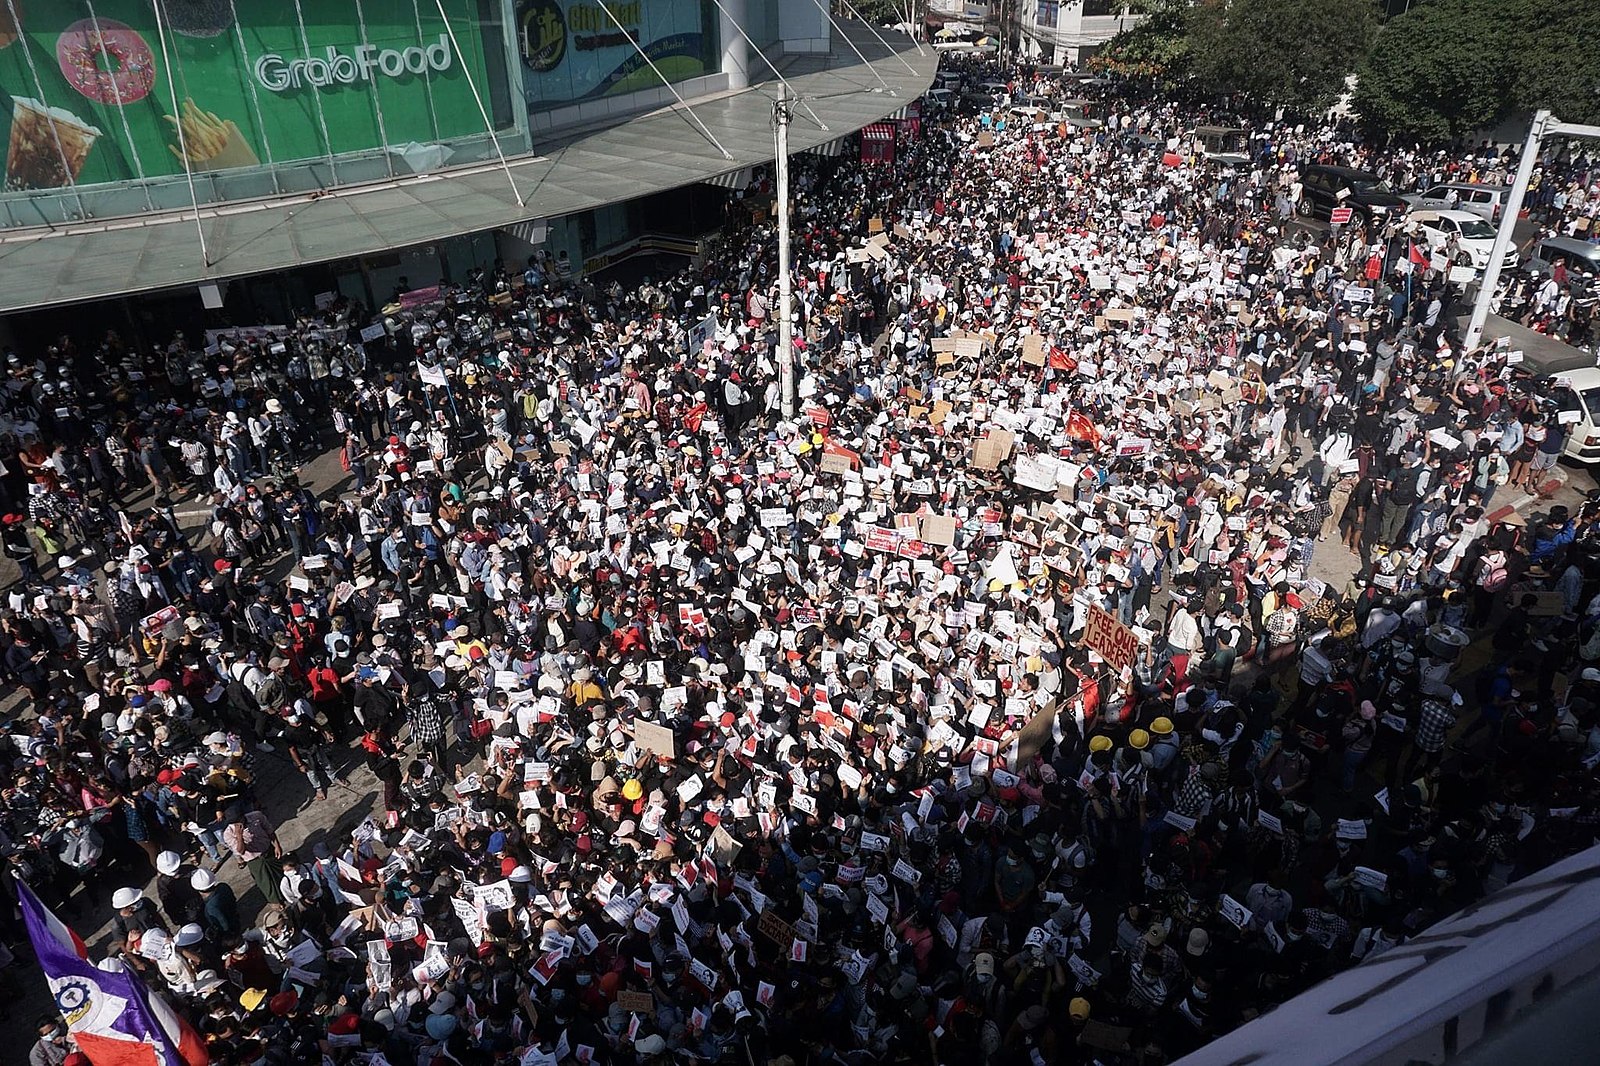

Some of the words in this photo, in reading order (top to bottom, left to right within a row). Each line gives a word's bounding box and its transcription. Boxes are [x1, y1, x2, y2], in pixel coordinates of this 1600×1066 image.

[255, 34, 450, 91] GrabFood
[1088, 604, 1114, 638] FREE
[1115, 626, 1138, 659] OUR
